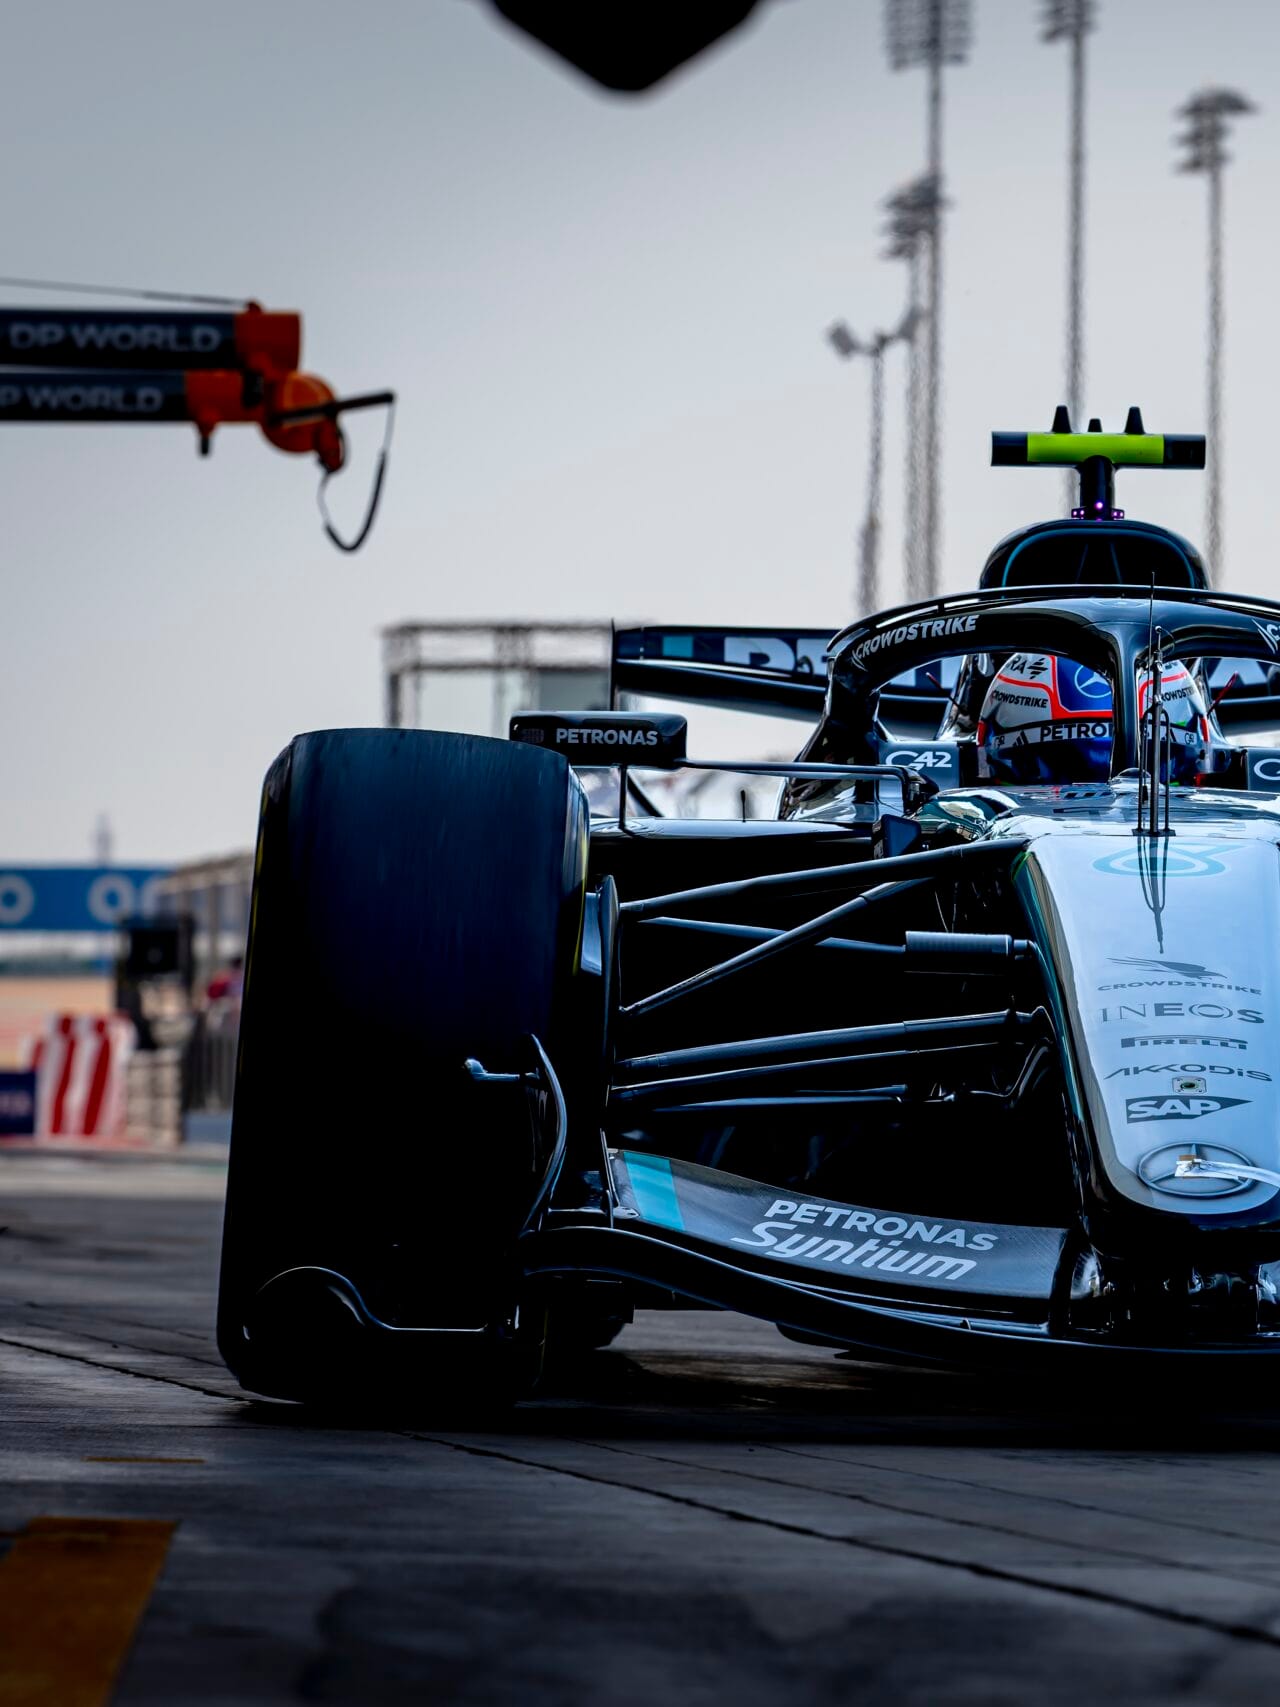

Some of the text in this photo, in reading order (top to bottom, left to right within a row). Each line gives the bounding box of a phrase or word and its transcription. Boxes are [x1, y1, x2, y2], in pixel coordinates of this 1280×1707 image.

[10, 323, 221, 352] DP WORLD
[26, 386, 163, 412] WORLD
[855, 614, 979, 660] CROWDSTRIKE
[555, 727, 659, 746] PETRONAS
[1041, 722, 1112, 741] PETRO
[885, 750, 953, 771] G42
[1097, 980, 1262, 996] CROWDSTRIKE
[1099, 1002, 1265, 1024] INEOS
[1121, 1034, 1248, 1050] PIRELLI
[1128, 1098, 1222, 1119] SAP
[764, 1199, 999, 1251] PETRONAS
[731, 1221, 977, 1281] Syntium
